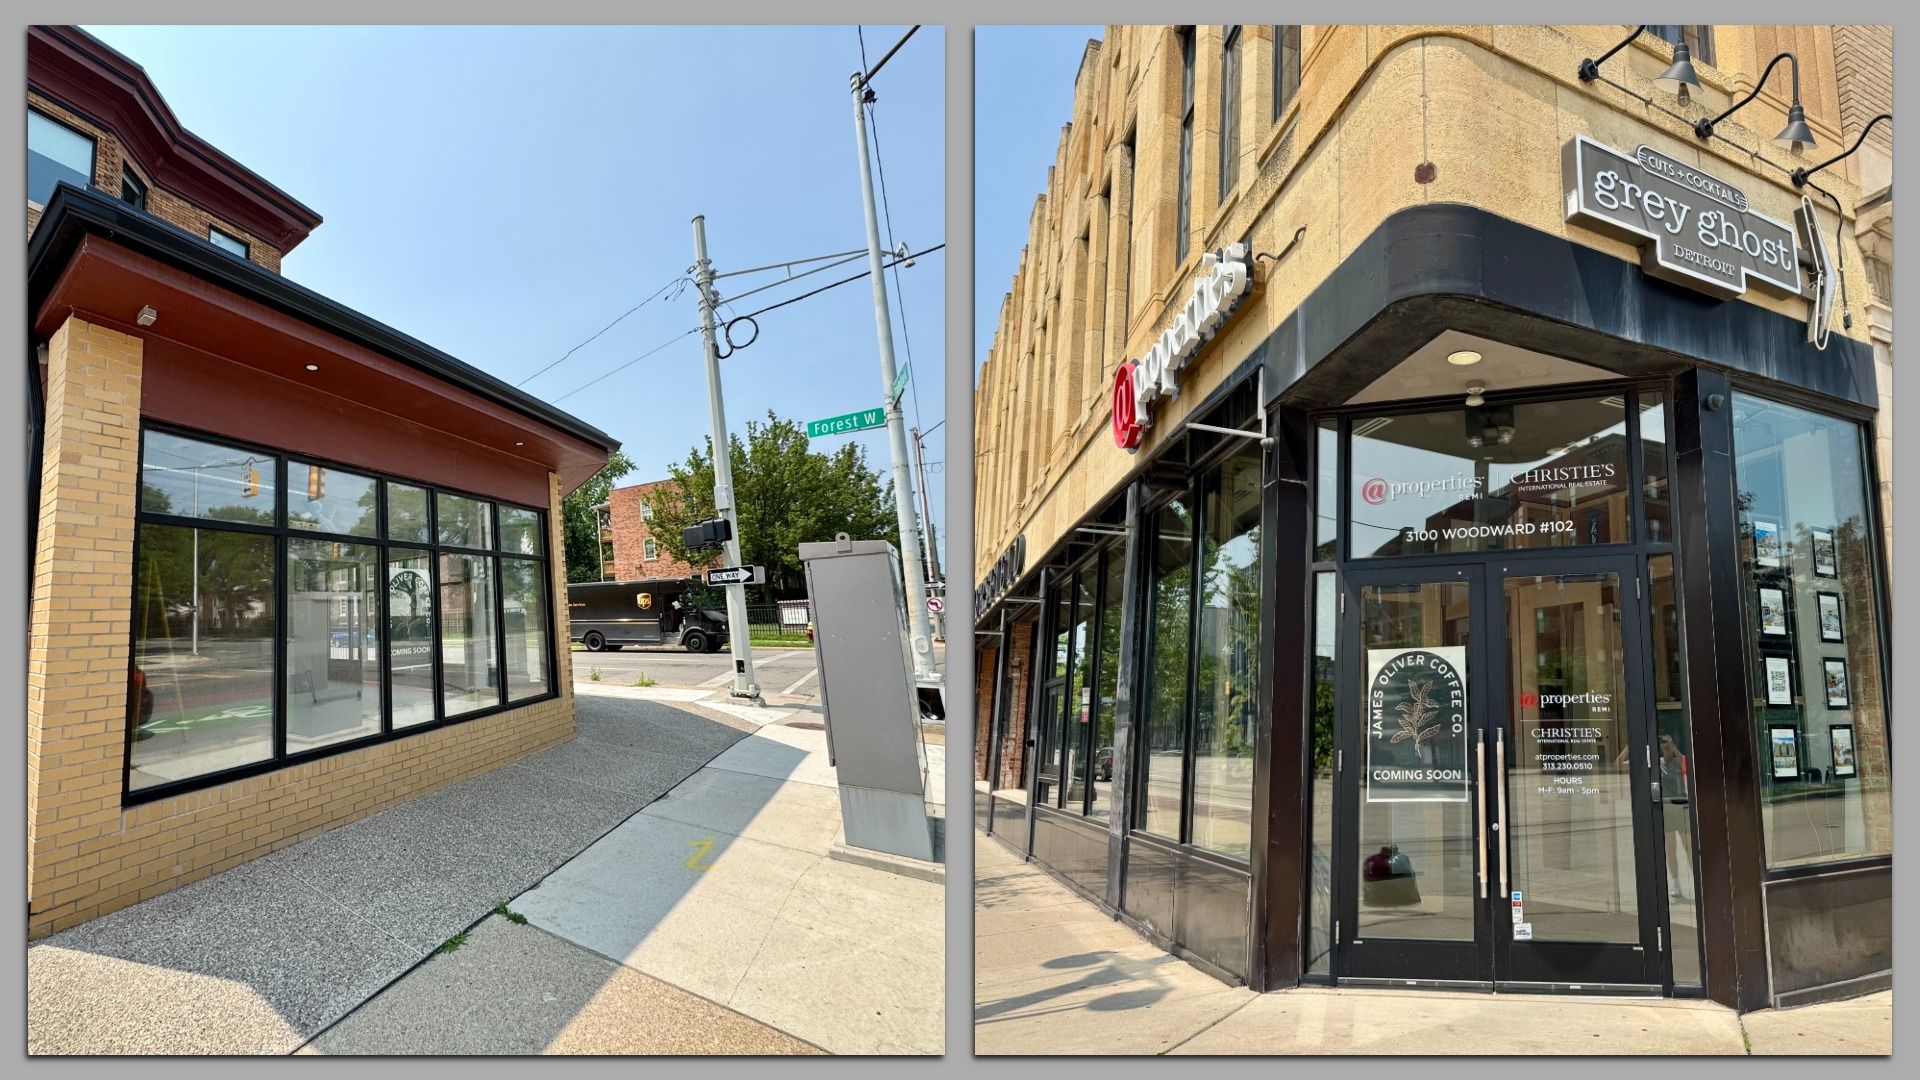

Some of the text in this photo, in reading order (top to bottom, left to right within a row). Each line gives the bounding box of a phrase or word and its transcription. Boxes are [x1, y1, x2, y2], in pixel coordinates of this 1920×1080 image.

[1647, 155, 1675, 178] CUTS
[1686, 171, 1741, 206] COCKTAILS
[1594, 169, 1791, 271] grey ghost
[1674, 244, 1735, 276] DETROIT
[1112, 242, 1246, 449] @properties
[814, 412, 876, 434] Forest W
[1510, 463, 1616, 485] CHRISTIE'S
[1361, 471, 1486, 506] @properties
[1518, 479, 1608, 492] INTERNATIONAL REAL ESTATE
[1458, 491, 1485, 501] REMI
[1406, 529, 1438, 543] 3100
[1442, 523, 1536, 539] WOODWARD
[1539, 519, 1575, 534] #102
[389, 573, 413, 592] OLIVER
[726, 571, 740, 579] WAY
[639, 597, 651, 607] ups
[1372, 654, 1463, 740] JAMES OLIVER COFFEE CO.
[1519, 689, 1612, 709] @properties
[1531, 727, 1602, 738] CHRISTIE'S
[1535, 753, 1600, 761] atproperties.com
[1542, 762, 1593, 770] 313.230.0510
[1373, 769, 1462, 781] COMING SOON
[1553, 777, 1583, 785] HOURS
[1556, 786, 1575, 795] 9am
[1581, 786, 1600, 797] 5pm
